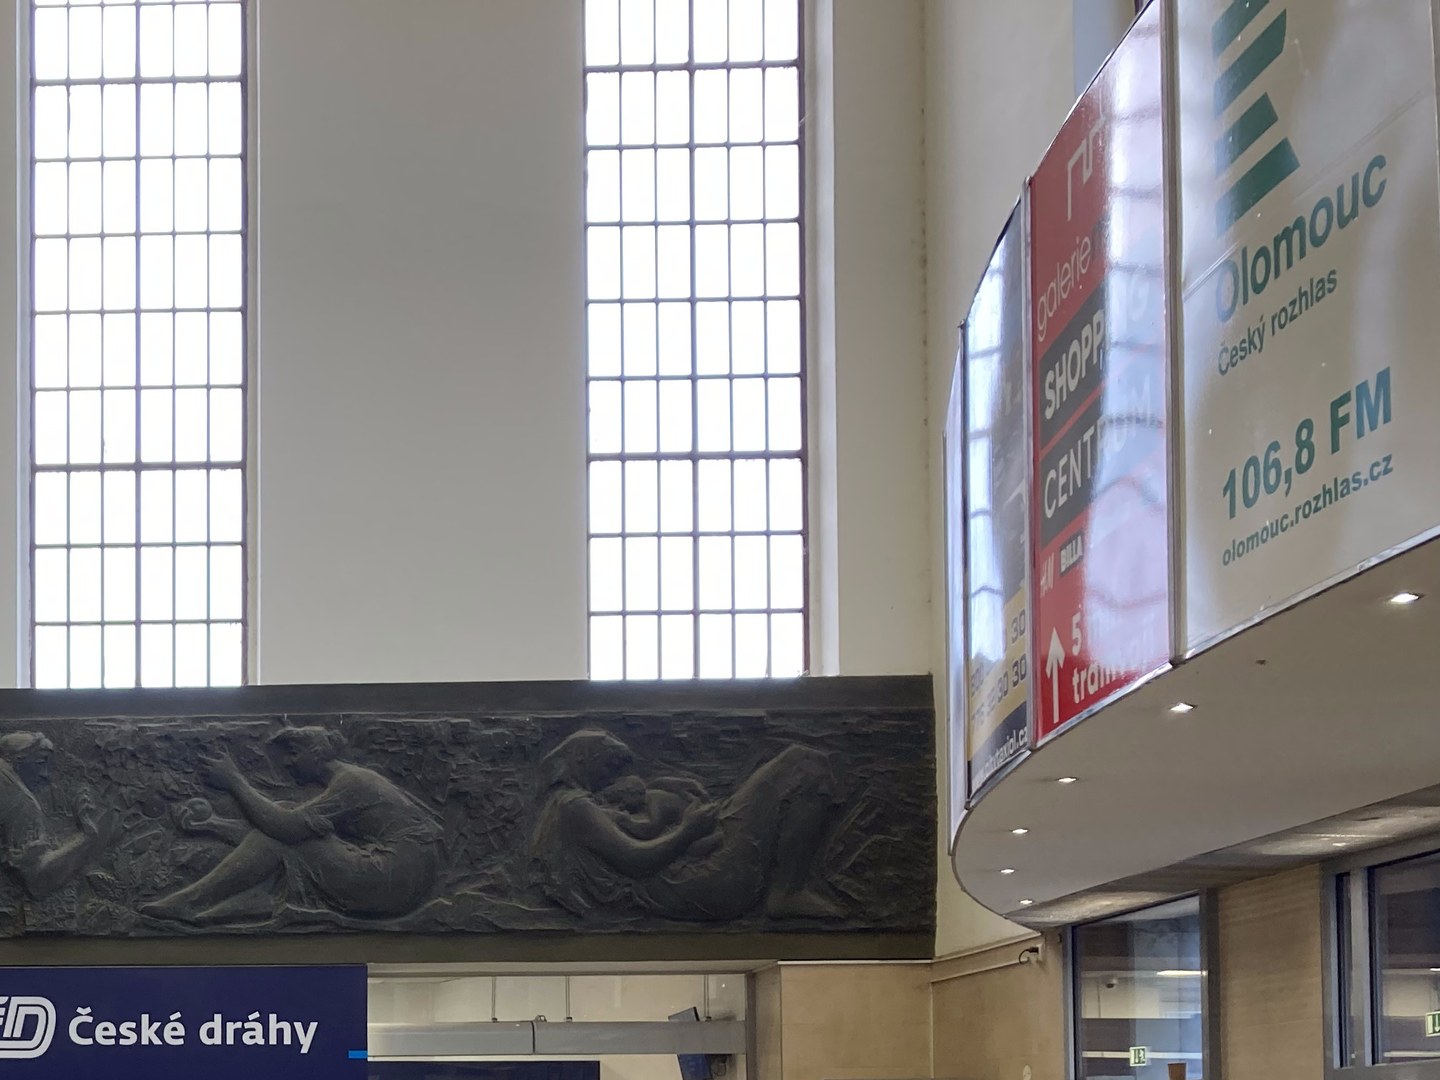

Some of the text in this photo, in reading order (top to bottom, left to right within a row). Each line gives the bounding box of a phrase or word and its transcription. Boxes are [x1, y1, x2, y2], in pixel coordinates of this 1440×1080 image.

[1037, 236, 1091, 343] galerie
[1215, 154, 1387, 322] Olomouc
[1218, 268, 1338, 376] Český rozhlas
[1223, 366, 1391, 520] 106,8 FM
[1222, 452, 1394, 566] olomouc.rozhlas.cz
[1012, 609, 1026, 644] 30
[1012, 654, 1026, 688] 30
[1071, 611, 1081, 656] 5
[68, 1006, 185, 1046] České
[199, 1010, 318, 1054] dráhy
